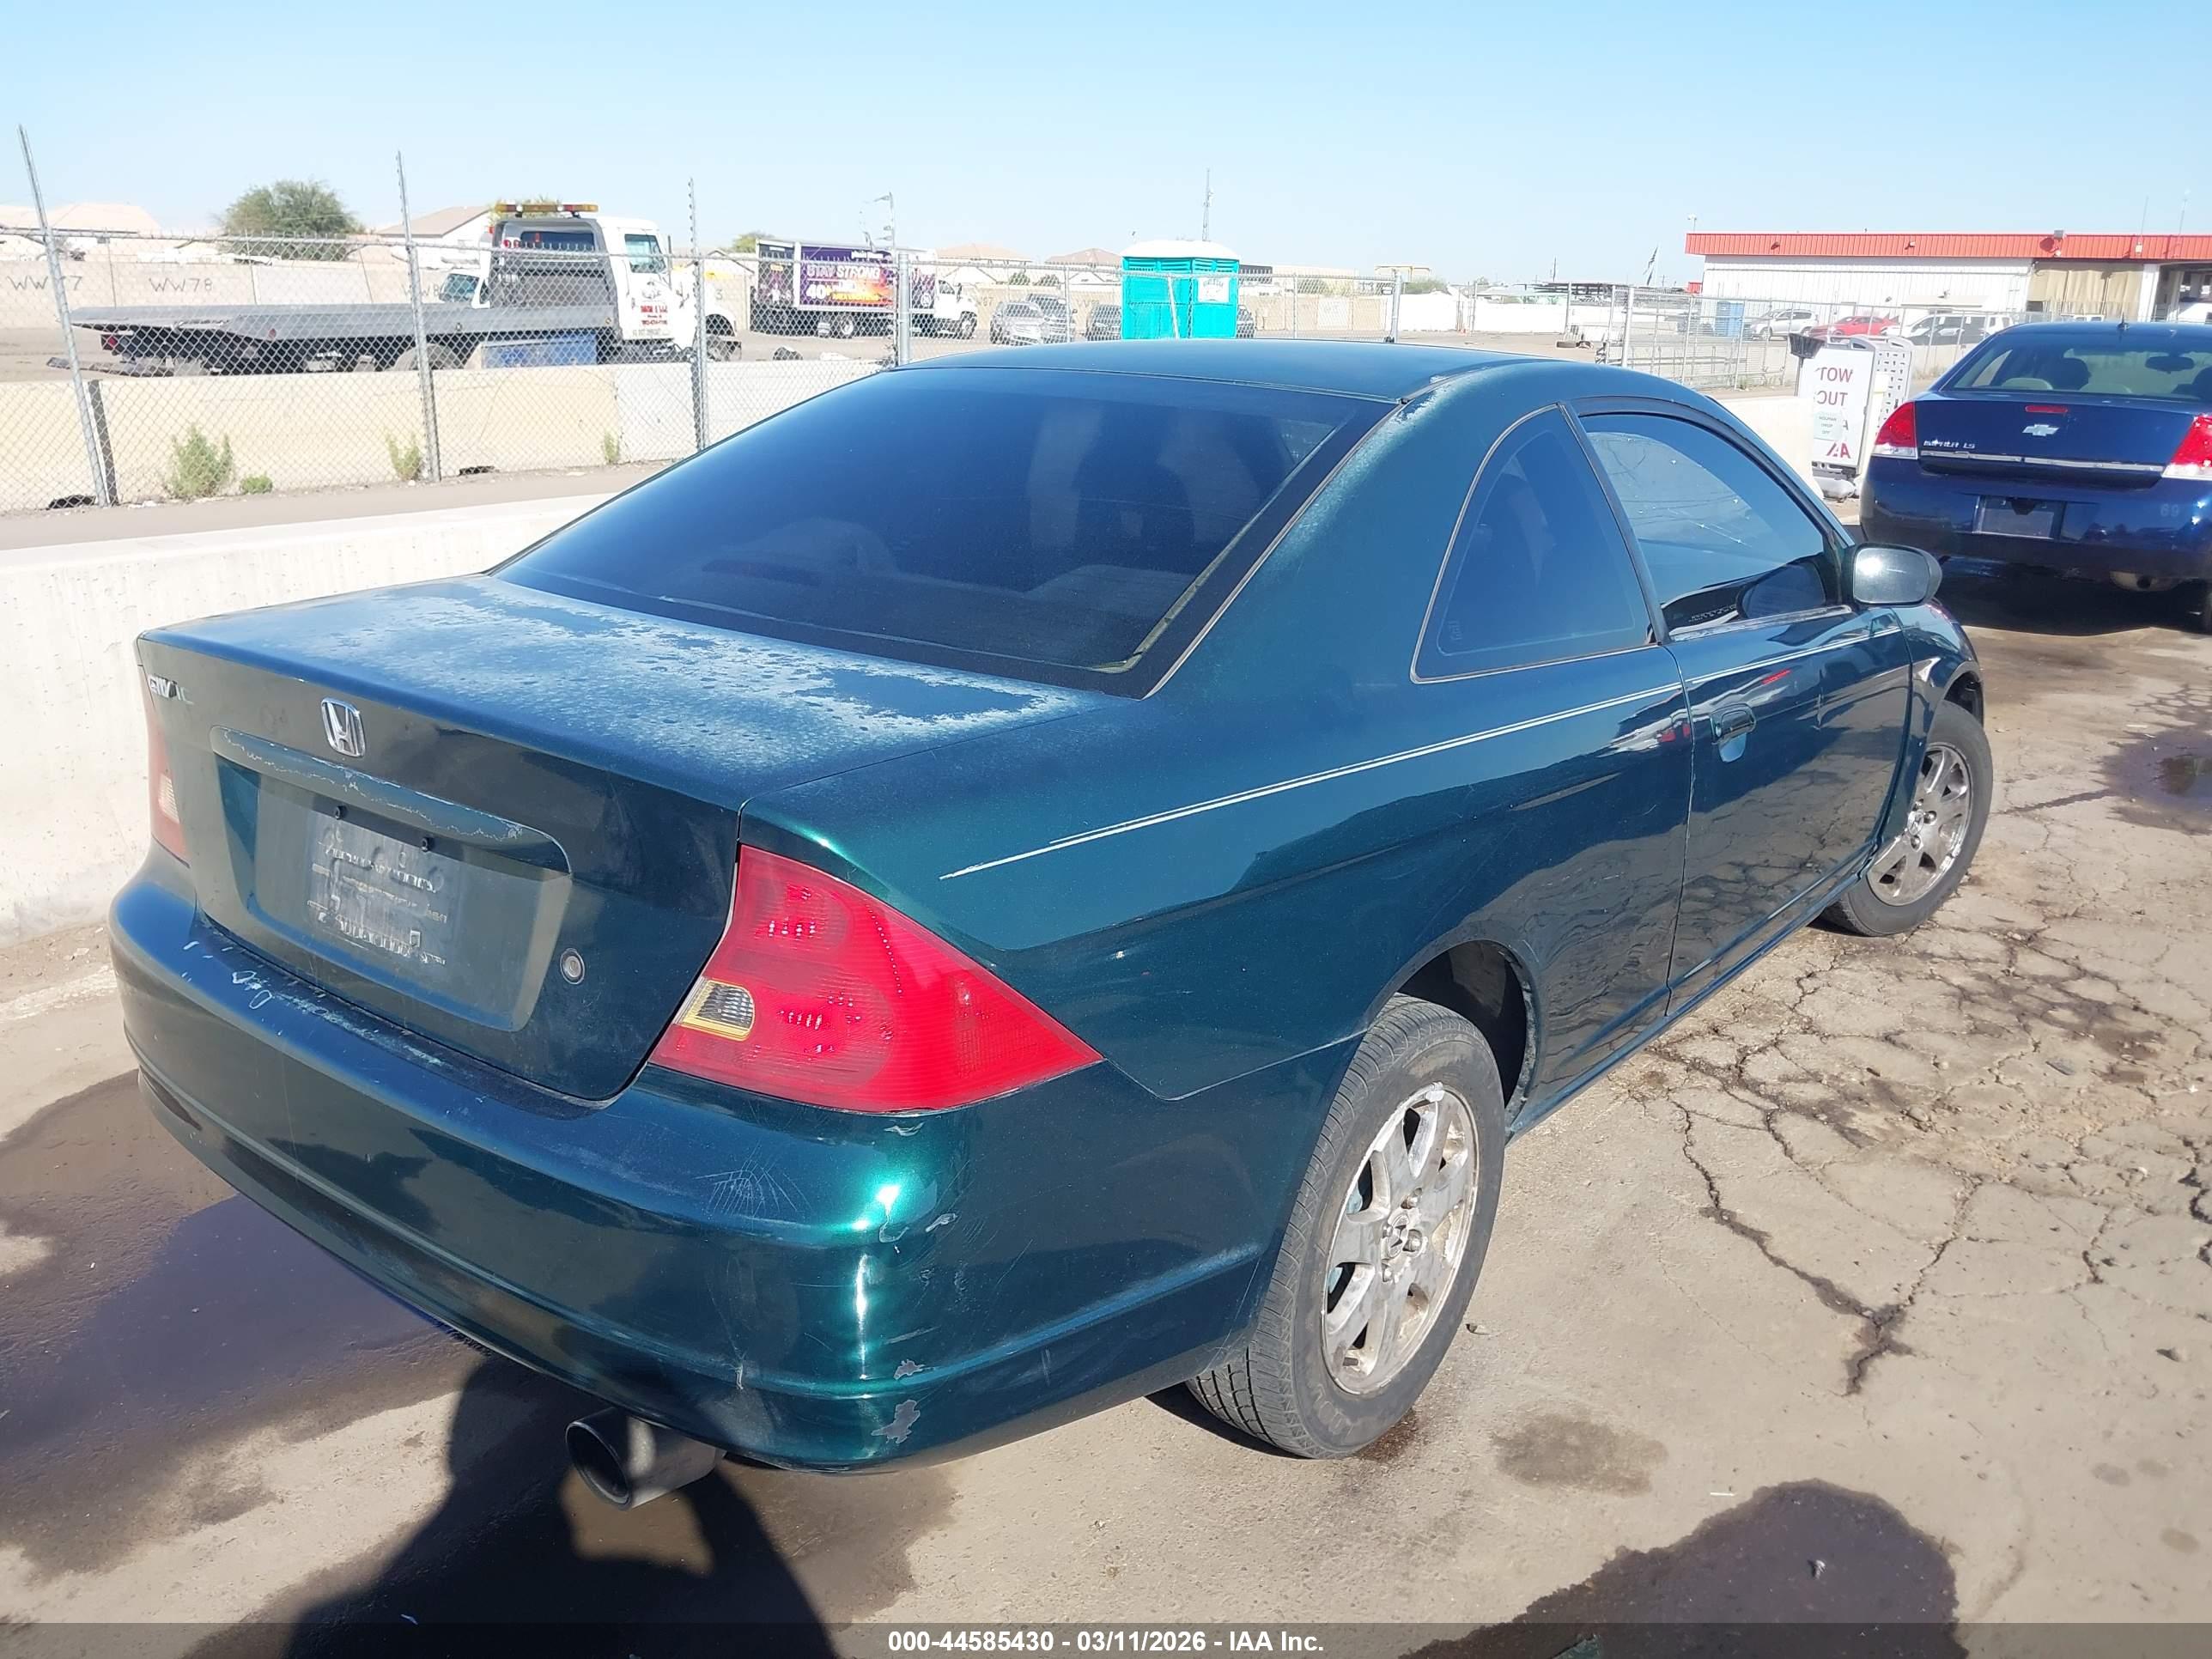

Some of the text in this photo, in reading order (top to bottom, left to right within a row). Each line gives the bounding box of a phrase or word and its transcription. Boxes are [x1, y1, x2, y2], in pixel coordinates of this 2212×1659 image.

[806, 264, 881, 279] STAY STRONG
[6, 275, 82, 291] WW7
[148, 276, 214, 292] WW78
[1814, 367, 1853, 383] TOW
[1814, 390, 1849, 407] OUT
